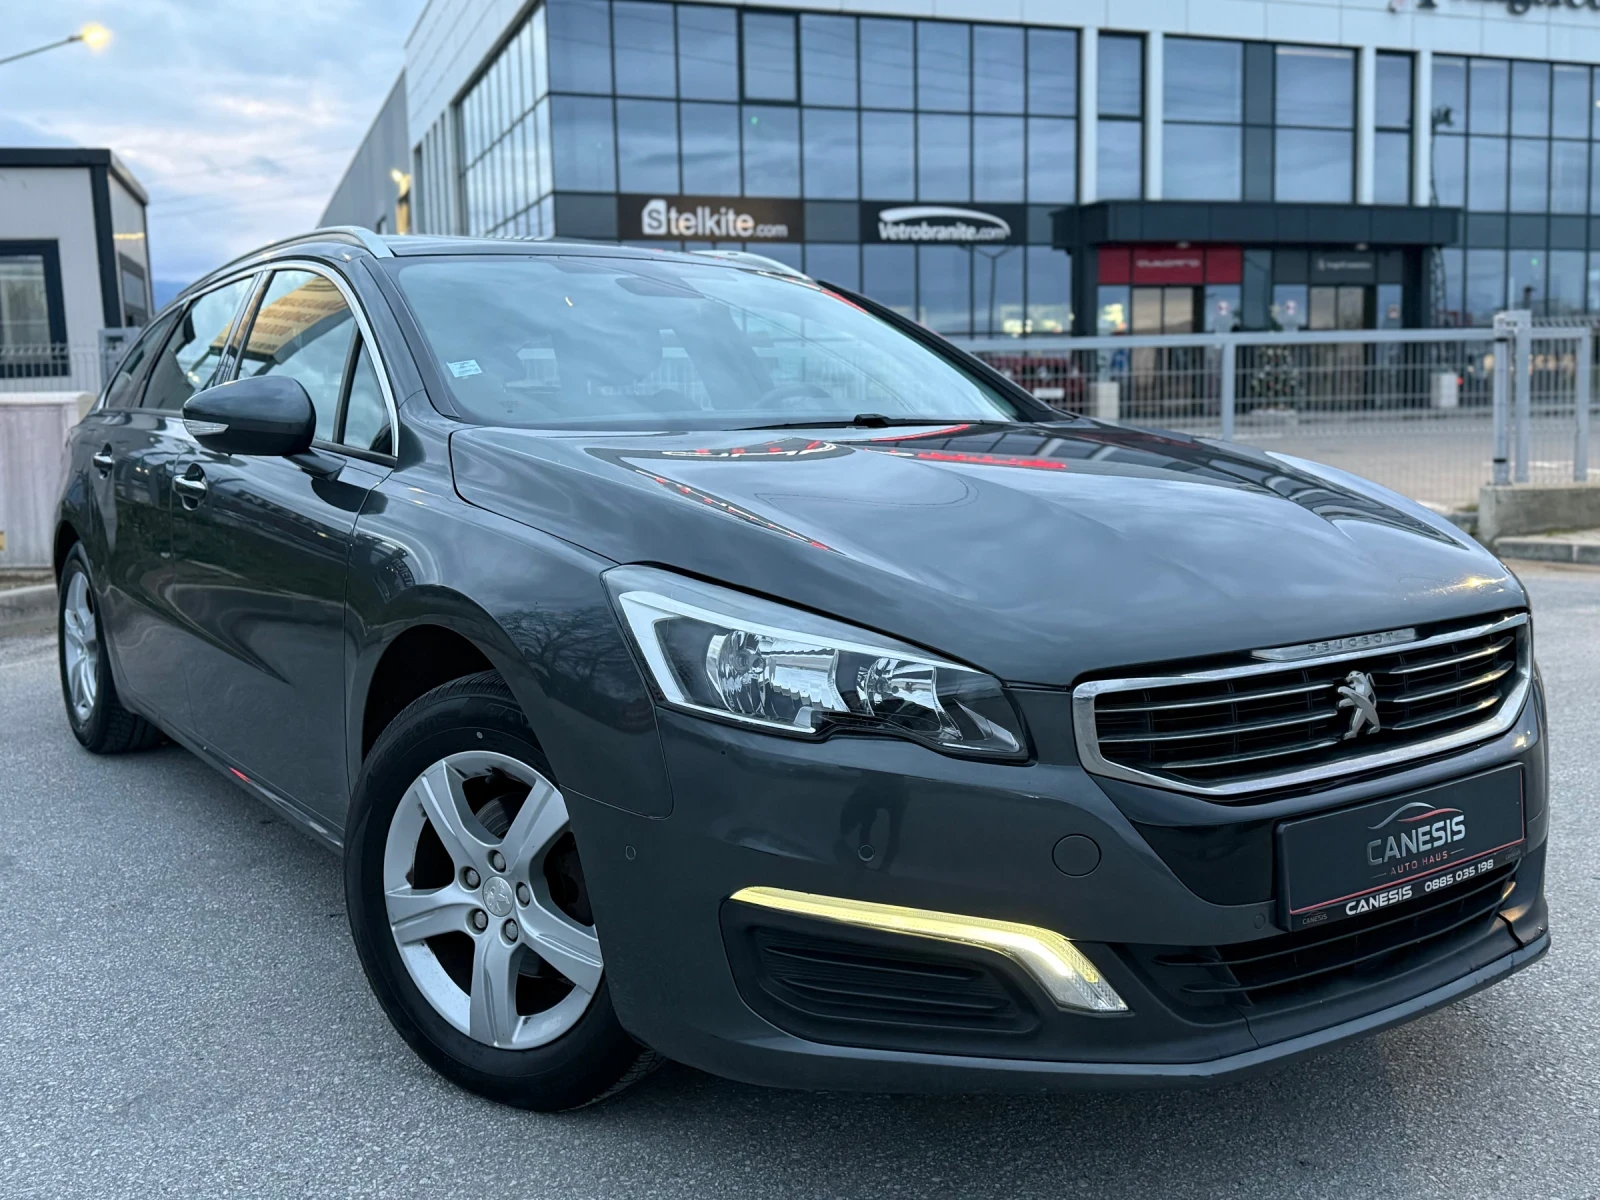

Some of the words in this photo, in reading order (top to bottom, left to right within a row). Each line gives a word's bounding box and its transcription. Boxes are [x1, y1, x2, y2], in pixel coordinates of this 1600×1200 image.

[642, 199, 788, 237] Stelkite.com
[1308, 632, 1393, 651] PEUGEOT
[1367, 815, 1466, 865] CANESIS
[1391, 860, 1418, 875] AUTO
[1422, 850, 1449, 865] HAUS
[1346, 886, 1412, 915] CANESIS
[1425, 875, 1454, 892] 0885
[1456, 866, 1475, 882] 035
[1477, 859, 1495, 874] 198
[1302, 913, 1328, 925] CANESIS
